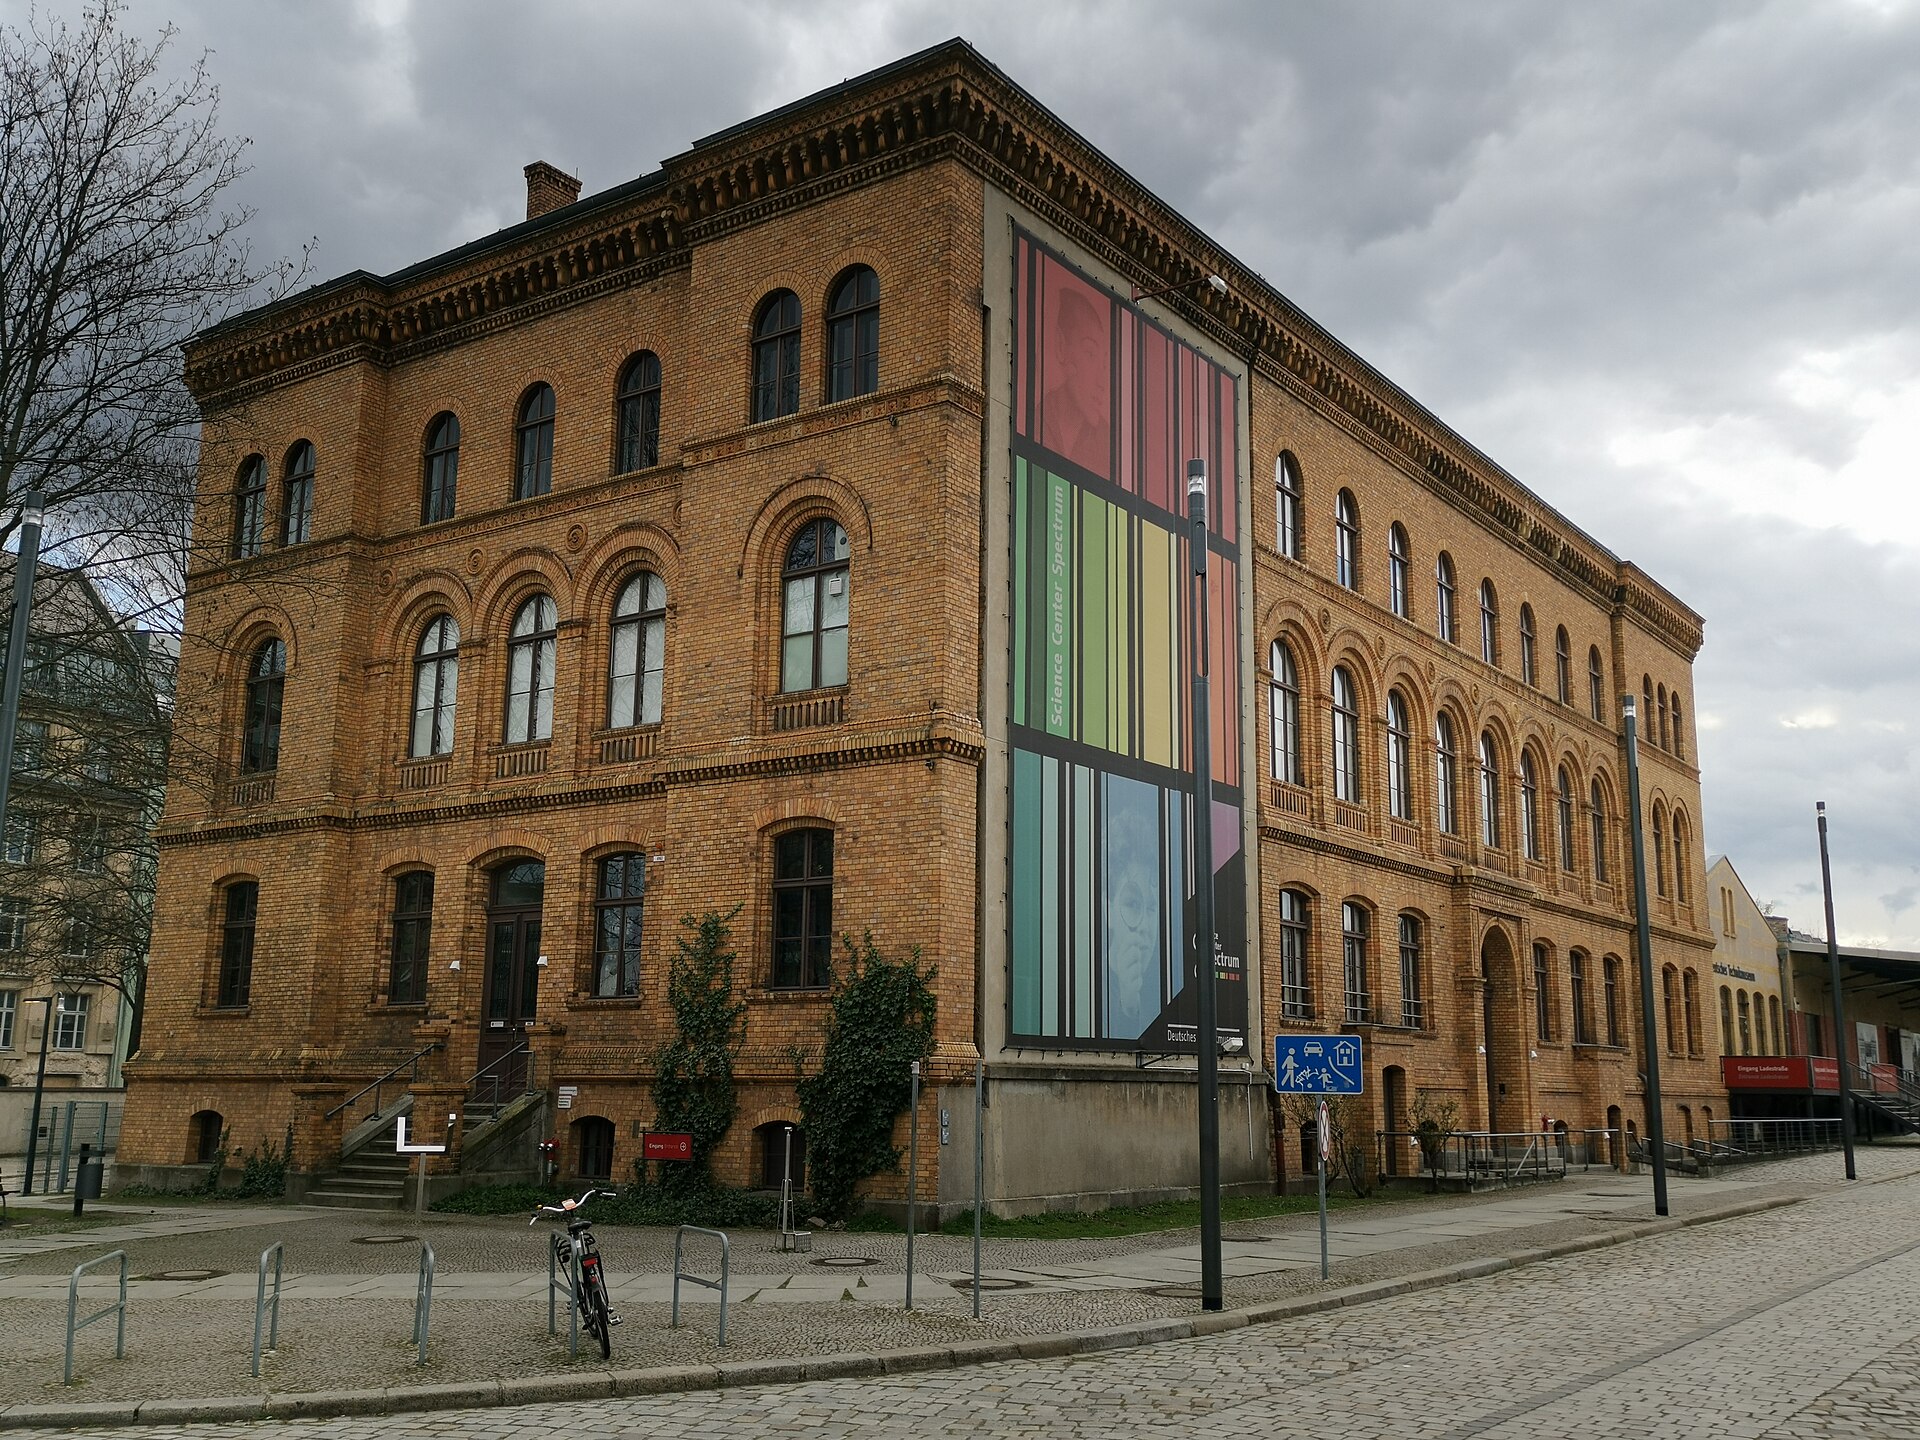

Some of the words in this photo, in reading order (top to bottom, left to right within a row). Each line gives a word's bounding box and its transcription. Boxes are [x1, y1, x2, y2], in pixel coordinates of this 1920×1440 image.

[1052, 485, 1066, 576] Spectrum
[1051, 581, 1063, 645] Center
[1051, 653, 1063, 728] Science
[1214, 952, 1240, 968] ectrum
[1167, 1030, 1197, 1043] Deutsches
[1737, 1065, 1759, 1073] Eingang
